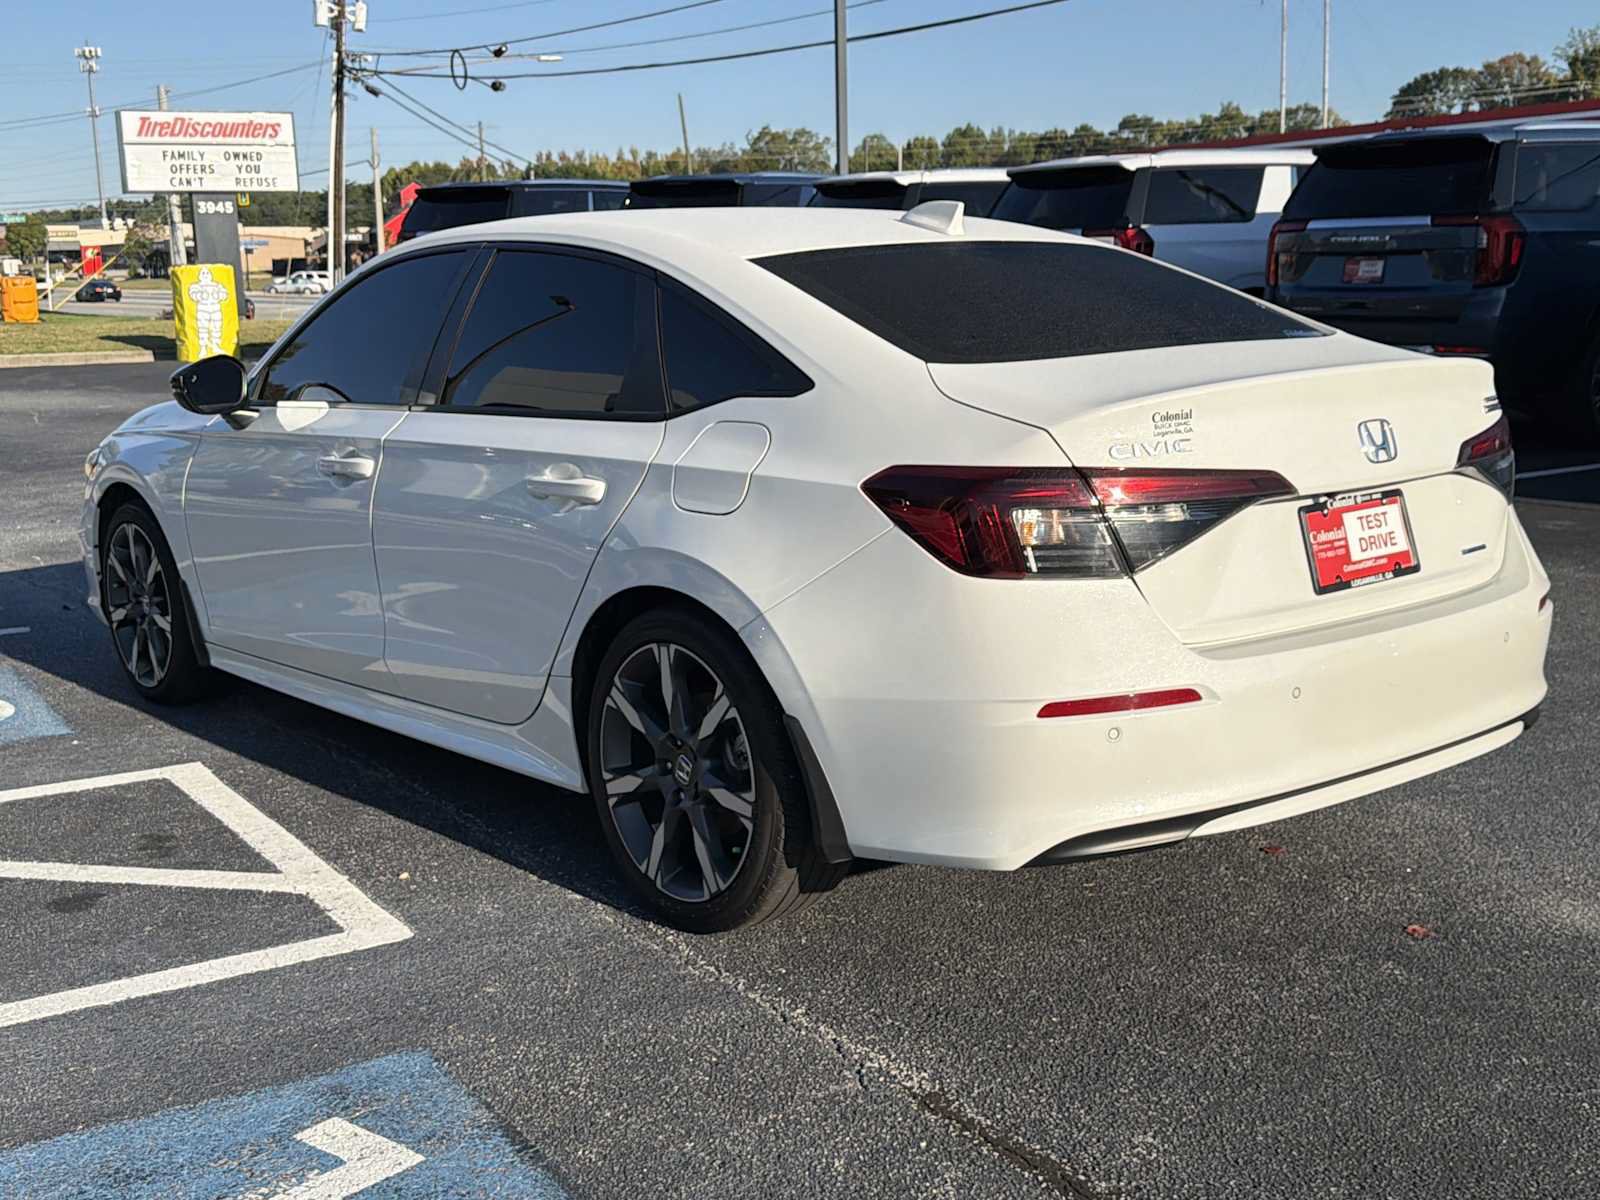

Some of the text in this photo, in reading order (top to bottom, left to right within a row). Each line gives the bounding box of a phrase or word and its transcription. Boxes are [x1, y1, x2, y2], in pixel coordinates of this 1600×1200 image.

[136, 116, 282, 139] TireDiscounters
[162, 151, 263, 162] FAMILY OWNED
[170, 164, 261, 174] OFFERS YOU
[170, 177, 279, 187] CAN'T REFUSE
[197, 201, 234, 214] 3945
[1151, 408, 1193, 423] Colonial
[1108, 438, 1192, 460] CIVIC
[1357, 511, 1389, 531] TEST
[1358, 530, 1398, 553] DRIVE
